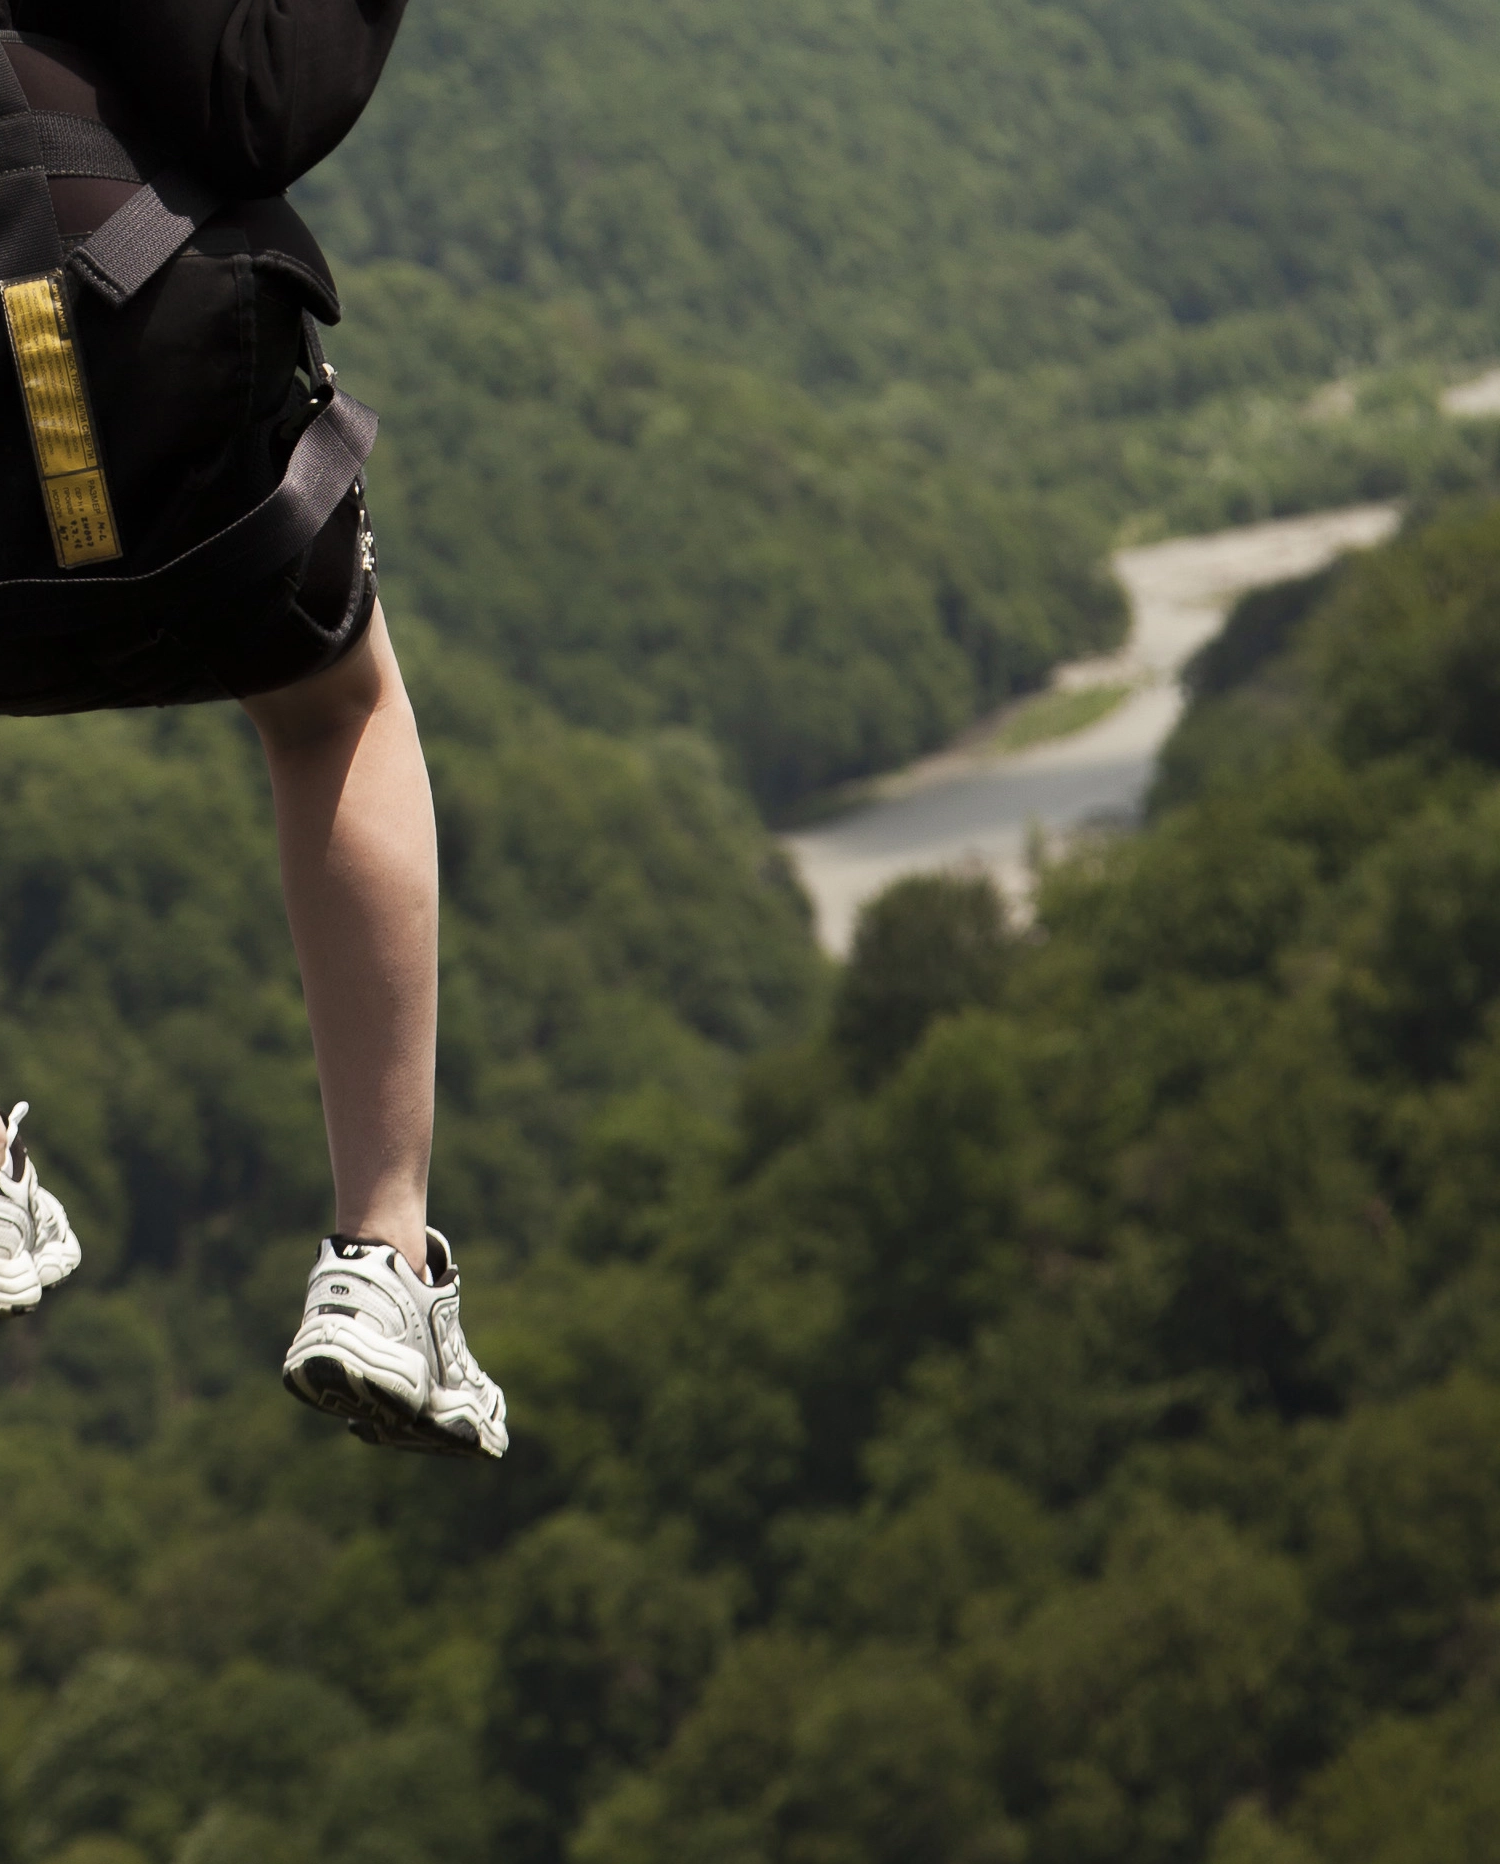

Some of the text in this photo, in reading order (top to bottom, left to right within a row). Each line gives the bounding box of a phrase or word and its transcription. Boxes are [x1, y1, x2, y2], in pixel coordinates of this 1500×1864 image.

[65, 347, 76, 373] РИСК
[77, 403, 88, 423] ИЛИ
[86, 479, 101, 514] РАЗМЕР
[343, 1244, 359, 1257] N
